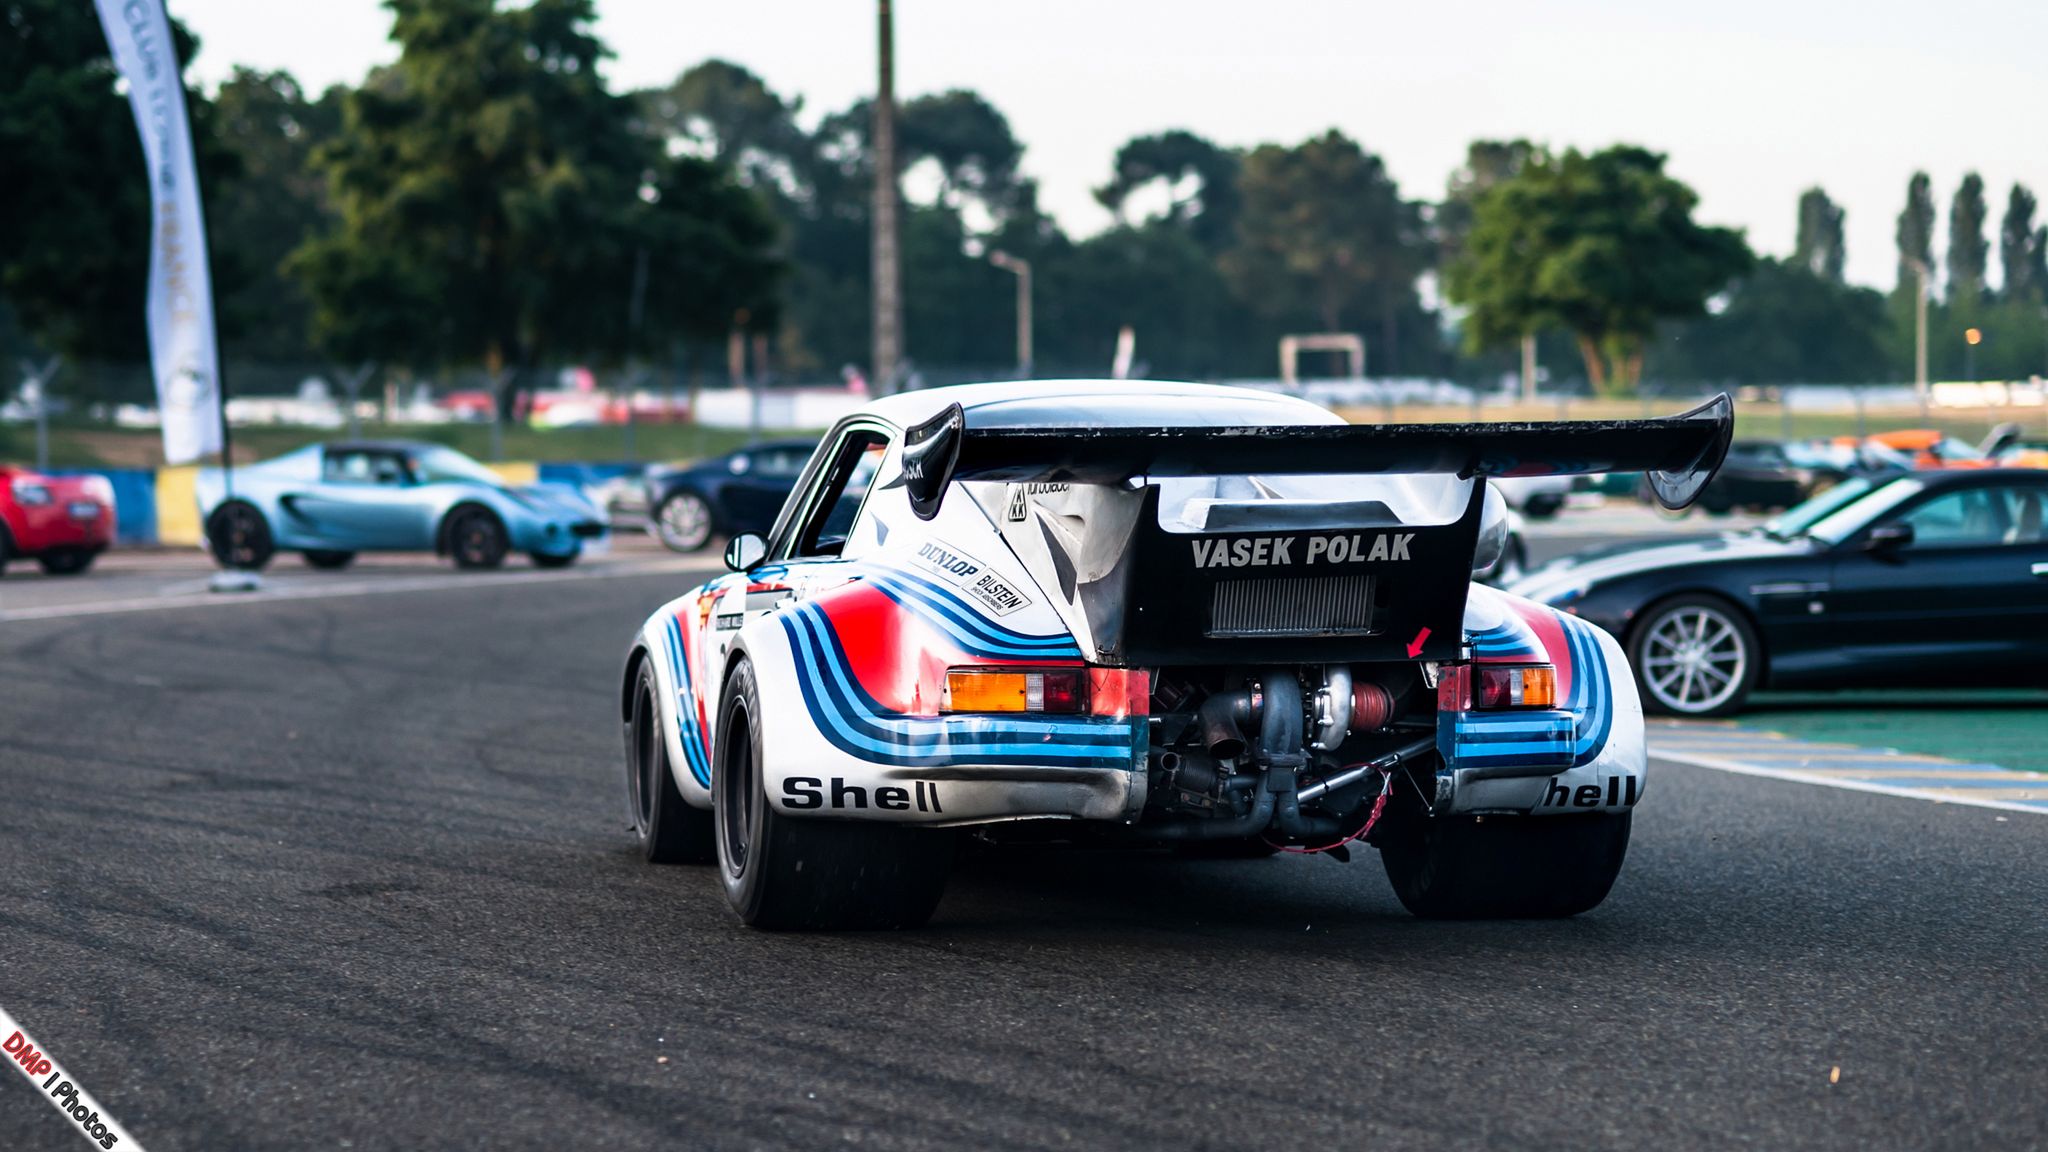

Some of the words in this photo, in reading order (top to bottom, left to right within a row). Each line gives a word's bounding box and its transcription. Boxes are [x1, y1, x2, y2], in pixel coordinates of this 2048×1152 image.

[918, 542, 979, 577] DUNLOP
[1192, 537, 1296, 568] VASEK
[1306, 533, 1416, 564] POLAK
[976, 574, 1023, 609] BILSTEIN
[782, 776, 943, 813] Shell
[1543, 775, 1636, 807] hell
